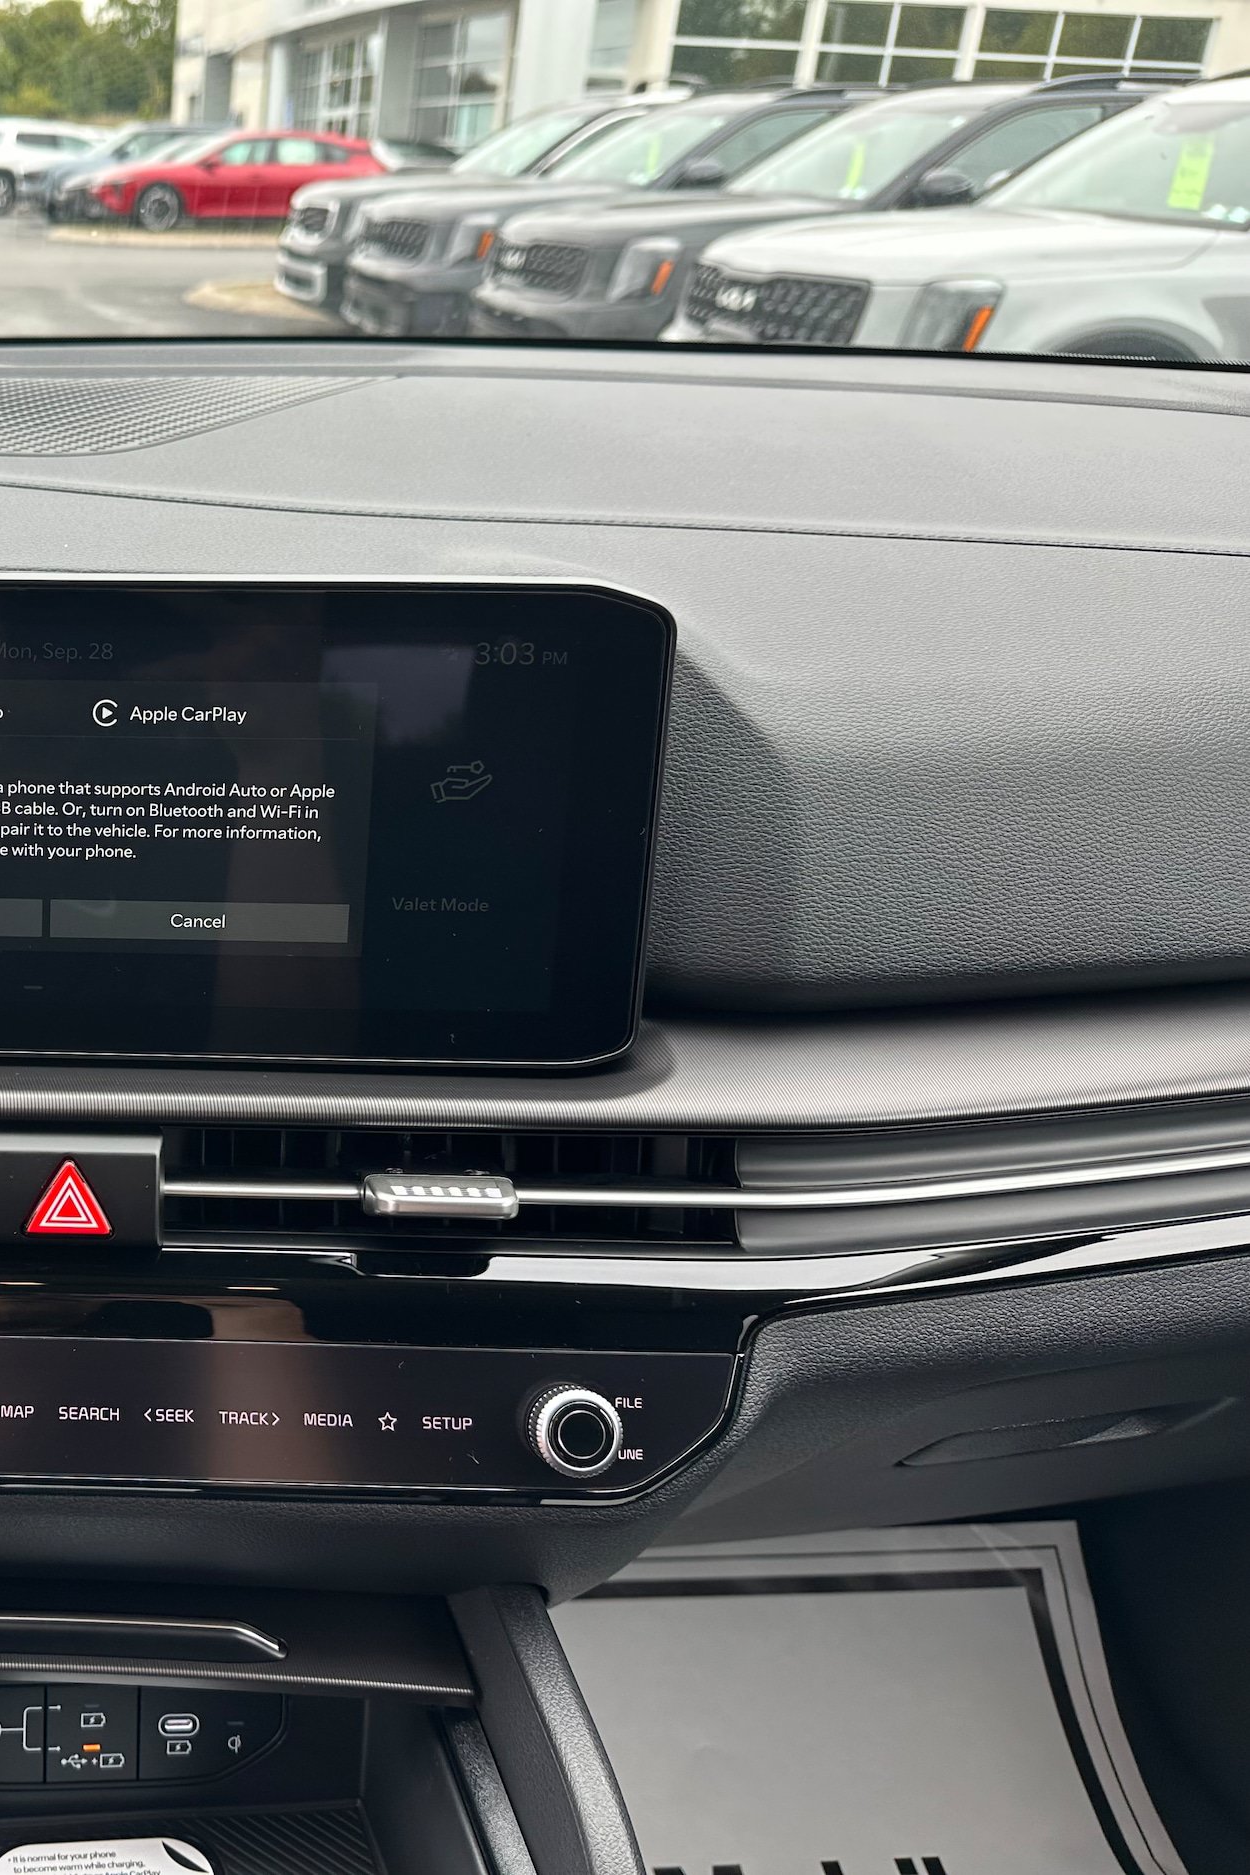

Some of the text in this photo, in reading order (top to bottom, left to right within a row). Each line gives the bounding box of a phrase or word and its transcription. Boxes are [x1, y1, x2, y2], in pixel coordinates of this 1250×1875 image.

[41, 642, 83, 664] Sep.
[88, 642, 114, 660] 28
[474, 641, 569, 665] 3:03 PM
[129, 706, 248, 725] Apple CarPlay
[7, 780, 56, 797] phone
[57, 781, 92, 796] that
[93, 783, 161, 799] supports
[163, 783, 226, 797] Android
[228, 784, 267, 798] Auto
[269, 787, 288, 798] or
[289, 784, 336, 801] Apple
[14, 802, 59, 816] cable.
[61, 802, 87, 819] Or,
[89, 804, 123, 817] turn
[125, 807, 145, 817] on
[149, 803, 224, 818] Bluetooth
[226, 805, 257, 819] and
[259, 805, 302, 819] Wi-Fi
[304, 806, 319, 819] in
[0, 823, 31, 839] pair
[33, 823, 45, 836] it
[46, 824, 63, 837] to
[65, 823, 92, 837] the
[94, 824, 151, 838] vehicle.
[154, 824, 180, 838] For
[182, 828, 223, 839] more
[226, 825, 322, 843] information,
[11, 843, 44, 857] with
[46, 846, 83, 860] your
[85, 844, 137, 861] phone.
[391, 896, 490, 912] Valet Mode
[170, 913, 226, 929] Cancel
[615, 1397, 643, 1409] FILE
[0, 1405, 35, 1419] MAP
[58, 1406, 120, 1422] SEARCH
[303, 1412, 353, 1427] MEDIA
[422, 1416, 473, 1431] SETUP
[616, 1449, 644, 1460] UNE
[19, 1855, 26, 1863] is
[27, 1853, 56, 1862] normal
[57, 1853, 69, 1861] for
[69, 1852, 88, 1861] your
[89, 1850, 117, 1860] phone
[23, 1865, 58, 1873] become
[59, 1863, 83, 1871] warm
[83, 1861, 106, 1870] while
